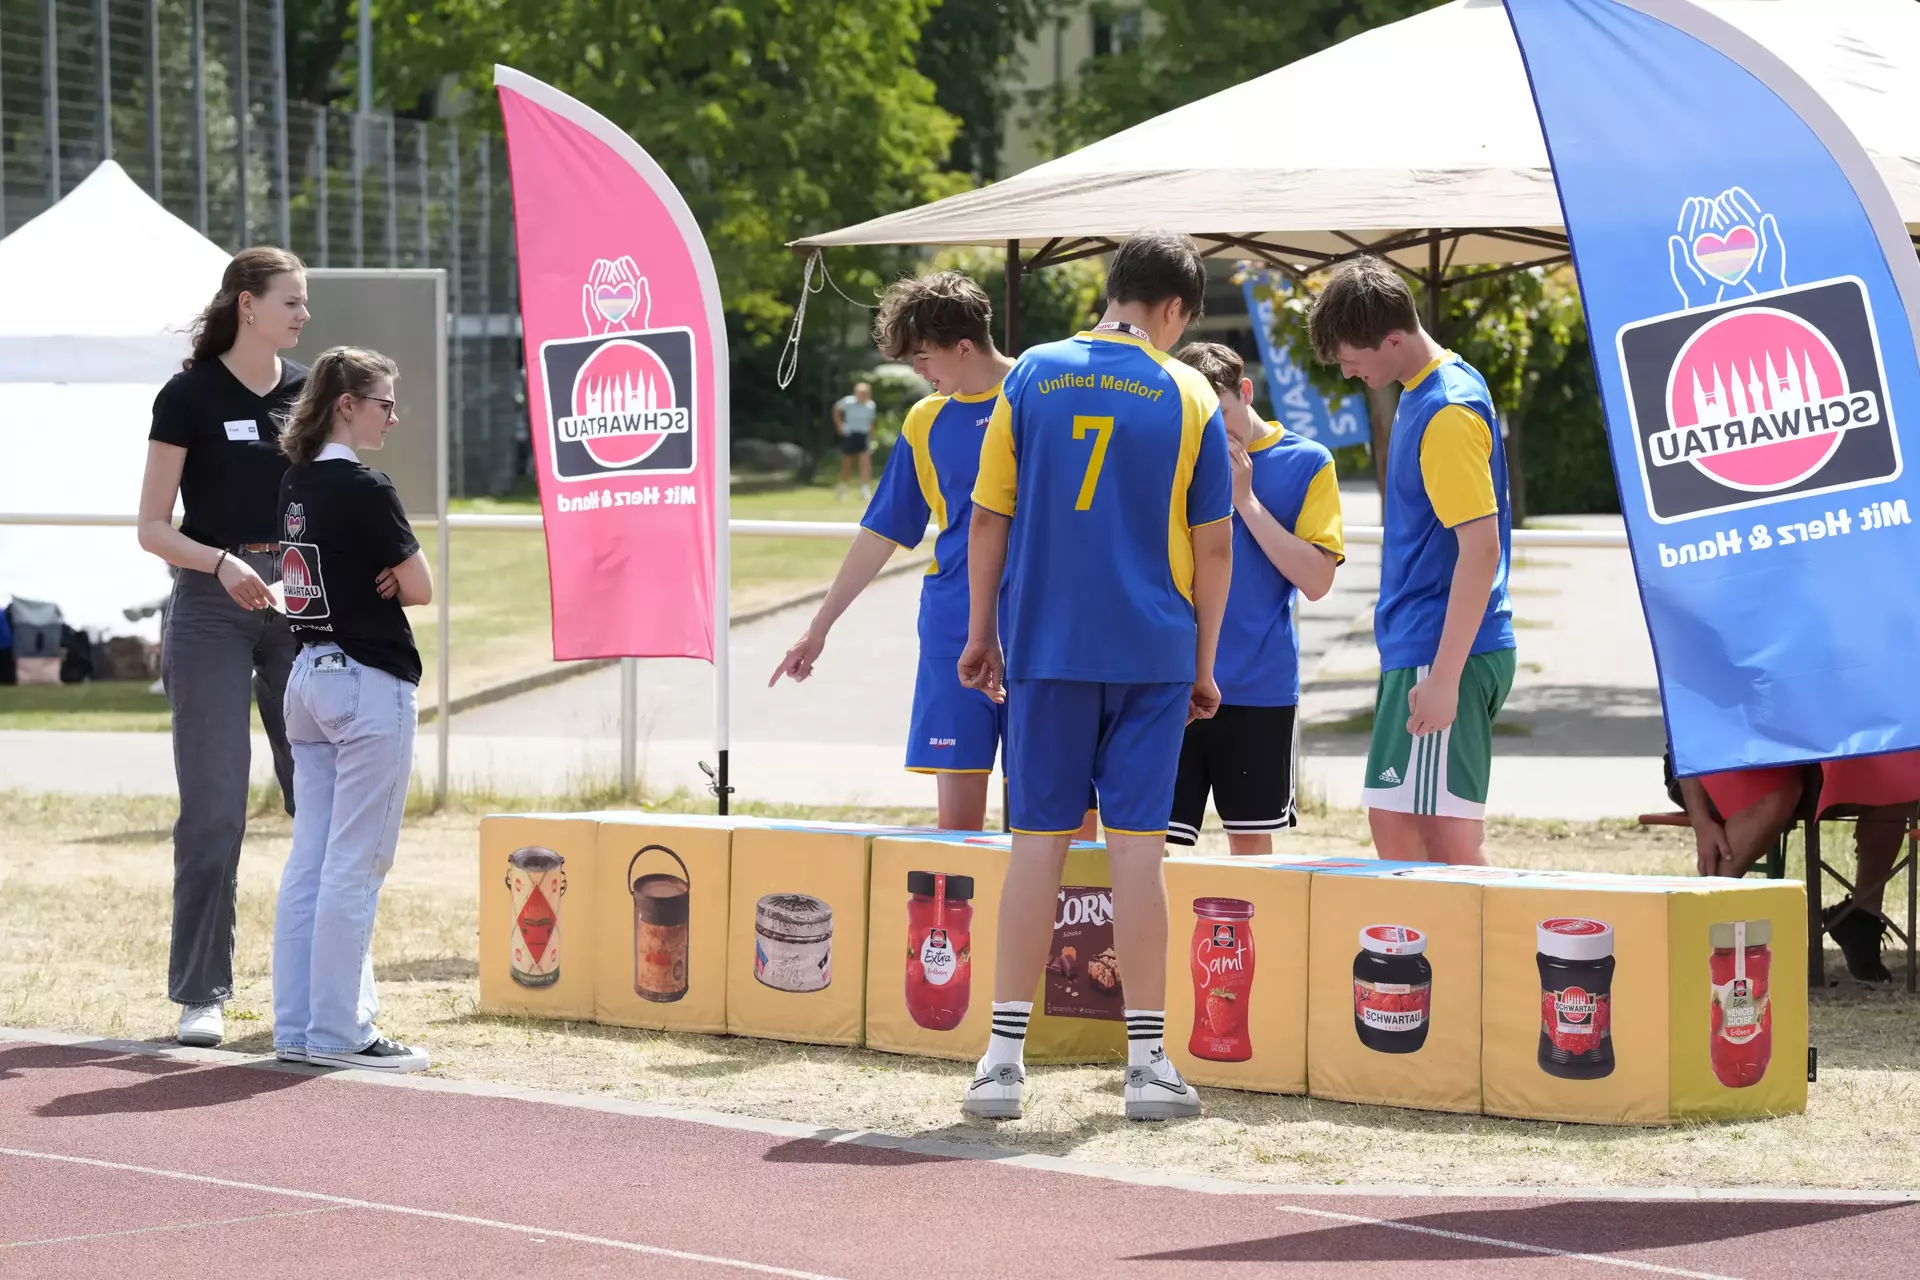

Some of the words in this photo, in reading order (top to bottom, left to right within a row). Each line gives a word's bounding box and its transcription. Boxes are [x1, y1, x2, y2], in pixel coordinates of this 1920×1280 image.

[1038, 373, 1095, 395] Unified
[1101, 375, 1164, 402] Meldorf
[1072, 415, 1114, 511] 7
[924, 949, 951, 966] Extra
[1197, 938, 1247, 988] Samt
[1555, 1002, 1596, 1012] SCHWARTAU
[1727, 1006, 1754, 1017] WENIGER
[1366, 1010, 1420, 1025] SCHWARTAU
